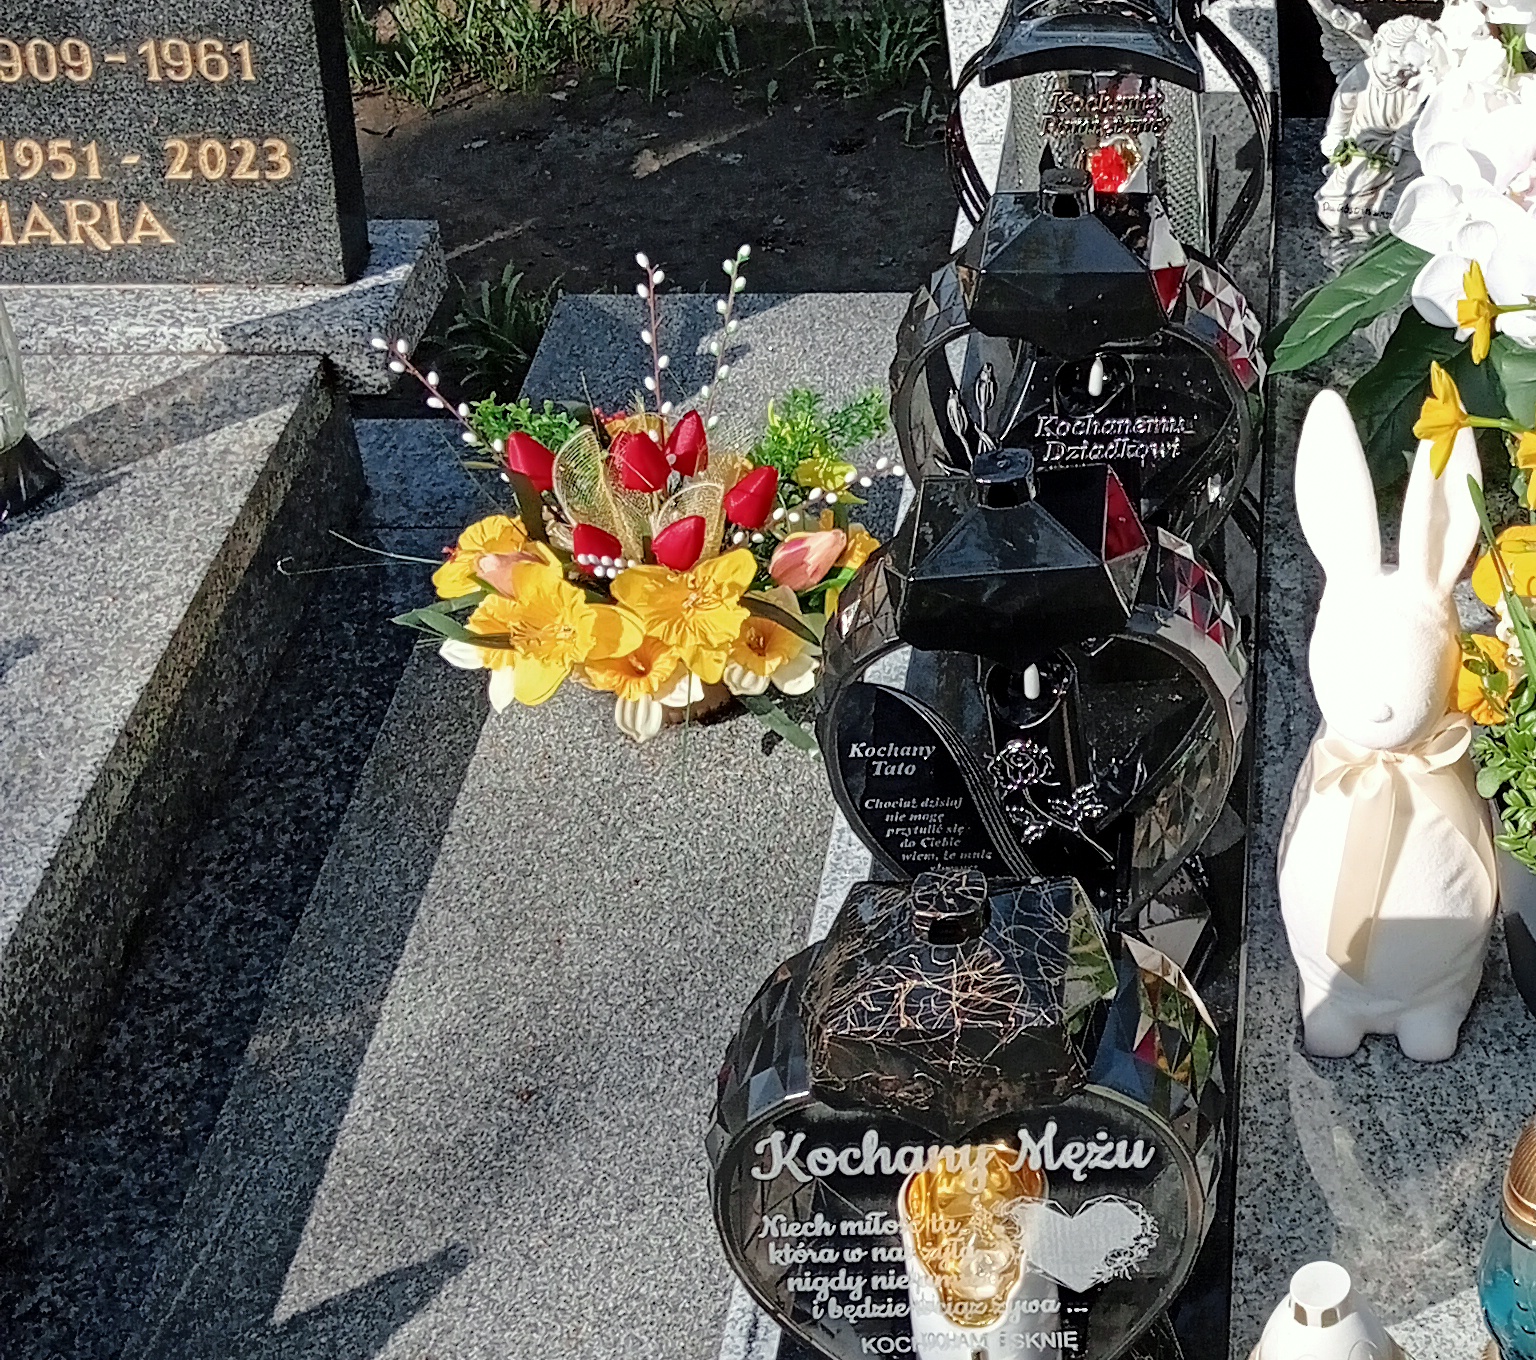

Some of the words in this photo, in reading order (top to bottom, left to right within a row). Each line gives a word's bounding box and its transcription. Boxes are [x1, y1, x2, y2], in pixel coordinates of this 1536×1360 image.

[138, 39, 256, 81] 1961
[163, 138, 292, 180] 2023
[848, 742, 937, 761] Kochany
[872, 761, 917, 776] Tato
[885, 812, 907, 823] nie
[750, 1129, 999, 1194] Kochany
[1007, 1120, 1156, 1182] Mężu
[757, 1211, 836, 1239] Niech
[768, 1241, 840, 1265] która
[842, 1246, 869, 1264] w
[786, 1268, 868, 1304] nigdy
[870, 1268, 909, 1291] nie
[827, 1295, 911, 1324] będzie
